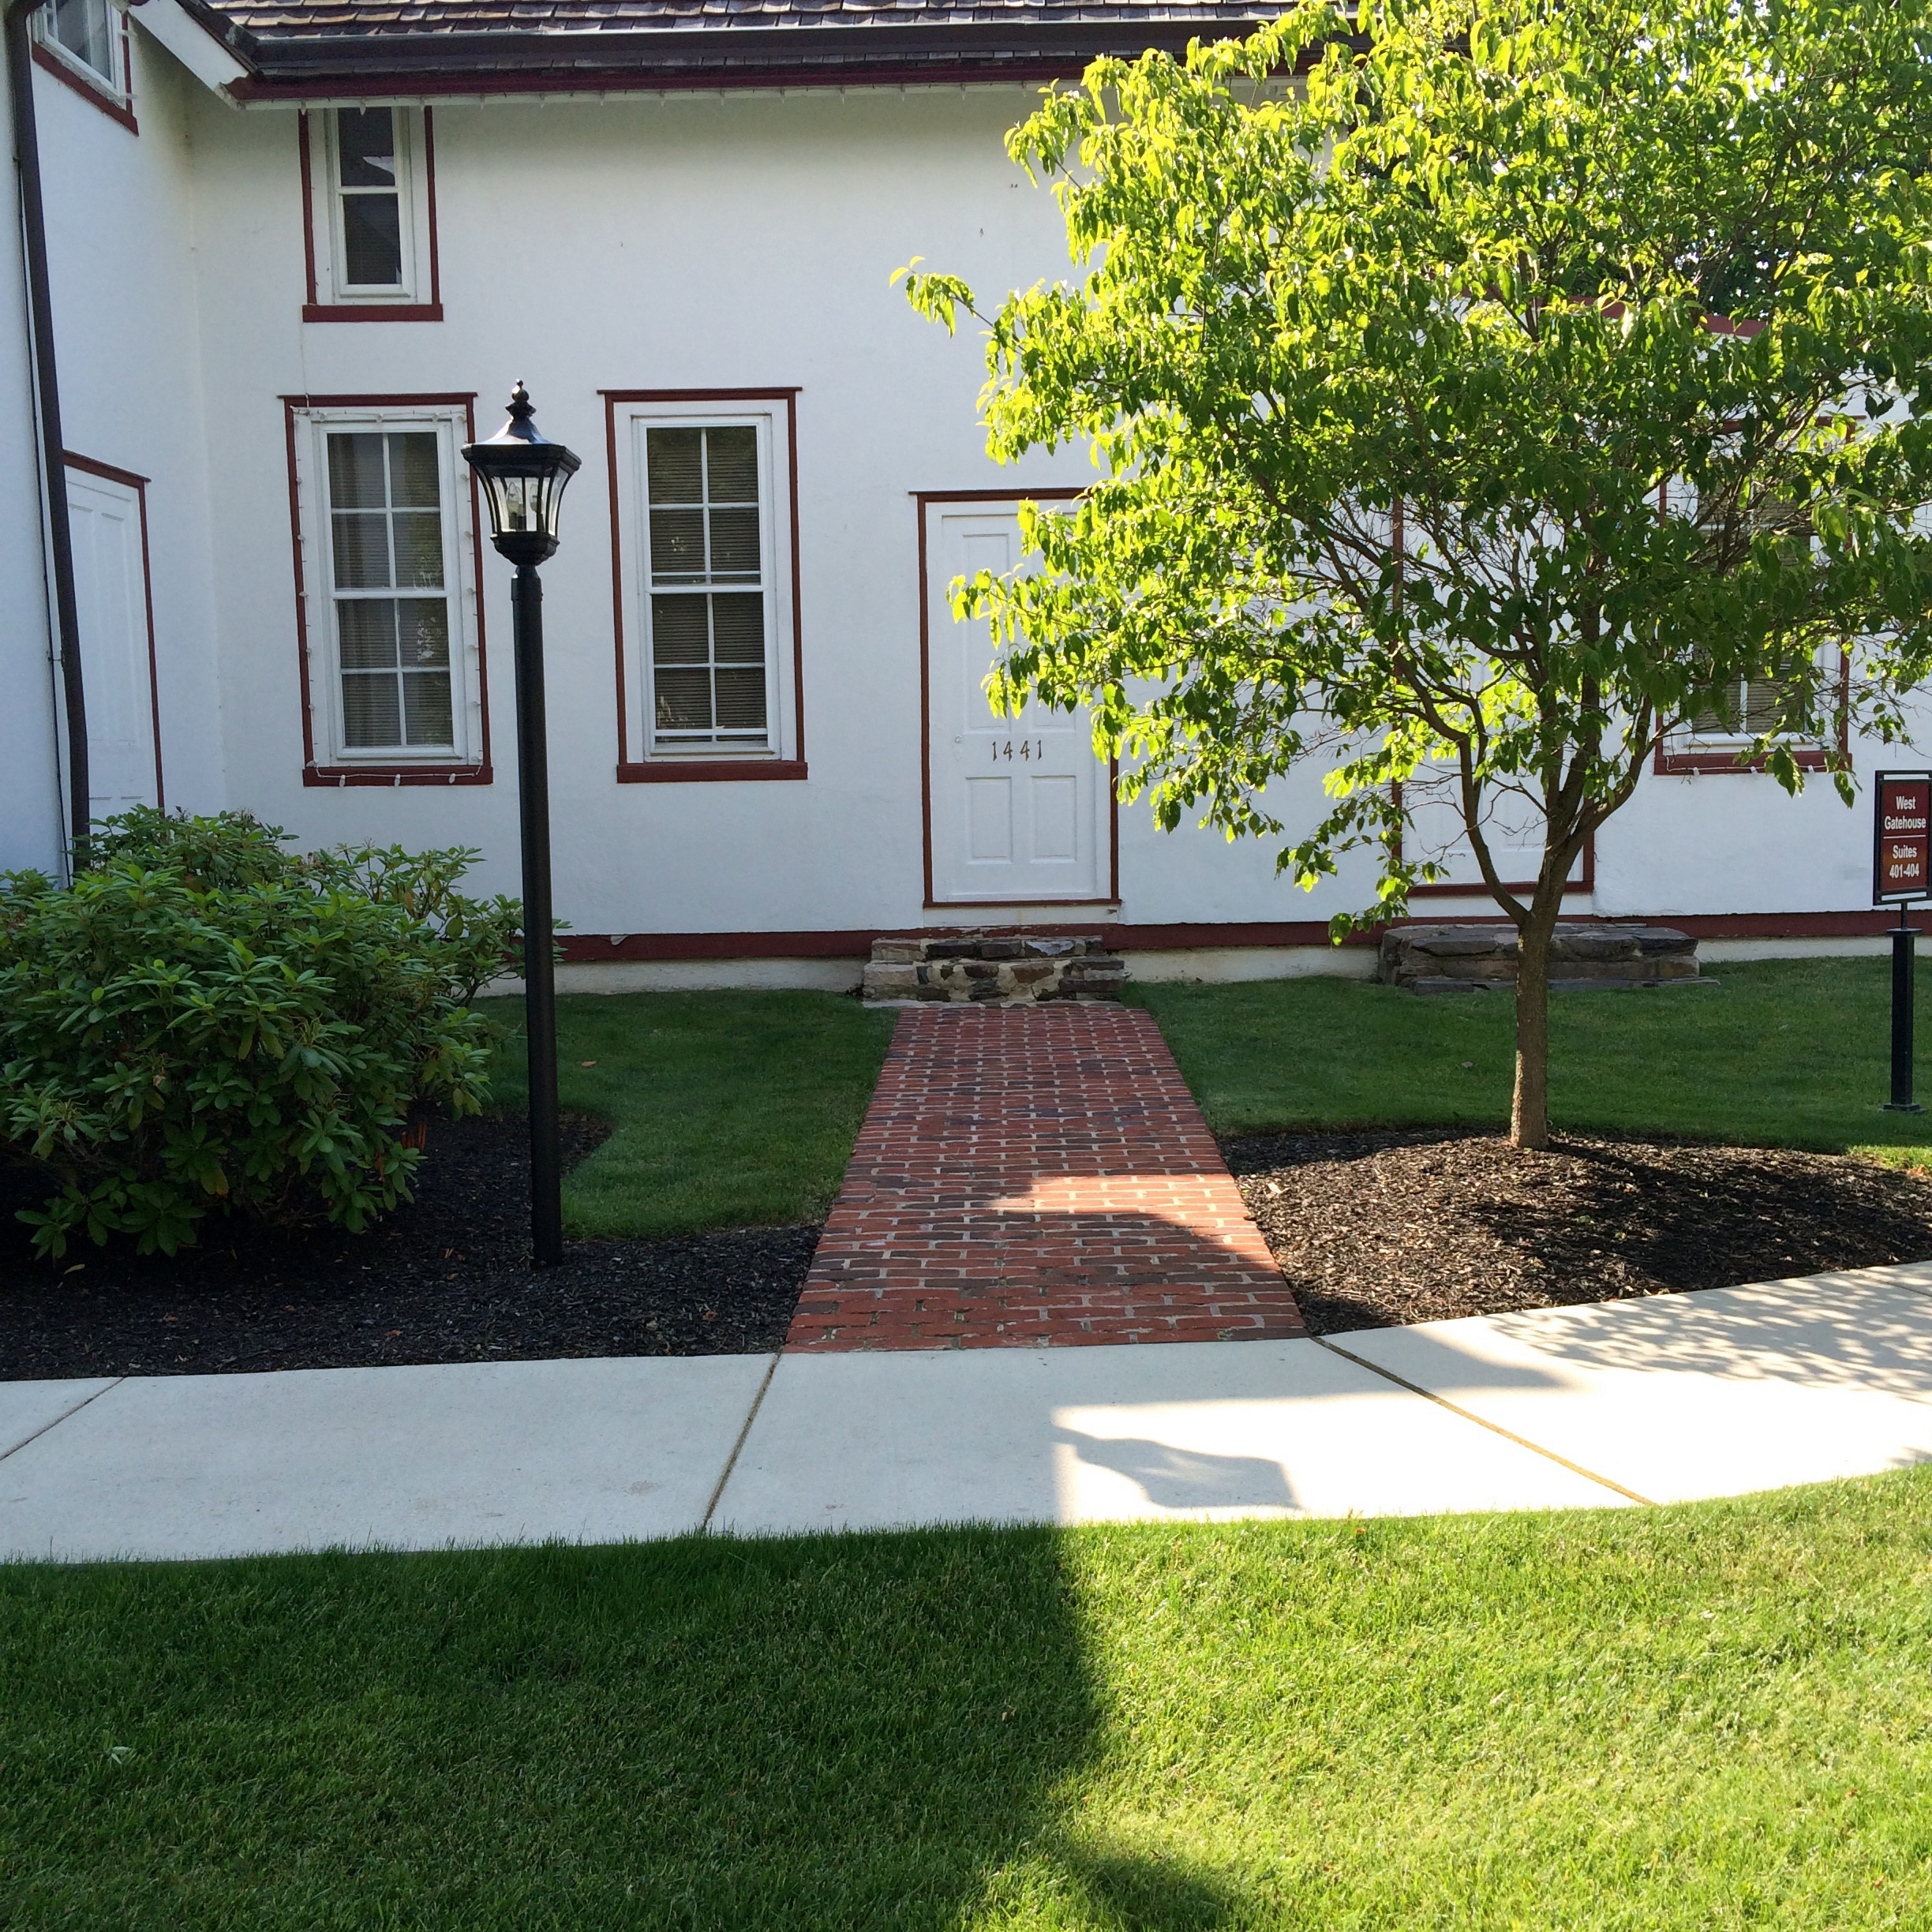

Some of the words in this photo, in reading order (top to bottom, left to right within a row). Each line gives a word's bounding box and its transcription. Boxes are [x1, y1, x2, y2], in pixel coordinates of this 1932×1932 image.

[992, 739, 1042, 761] 1441
[1896, 796, 1915, 810] West
[1884, 815, 1926, 829] Gatehouse
[1893, 844, 1917, 859] Suites
[1889, 863, 1919, 878] 401-404
